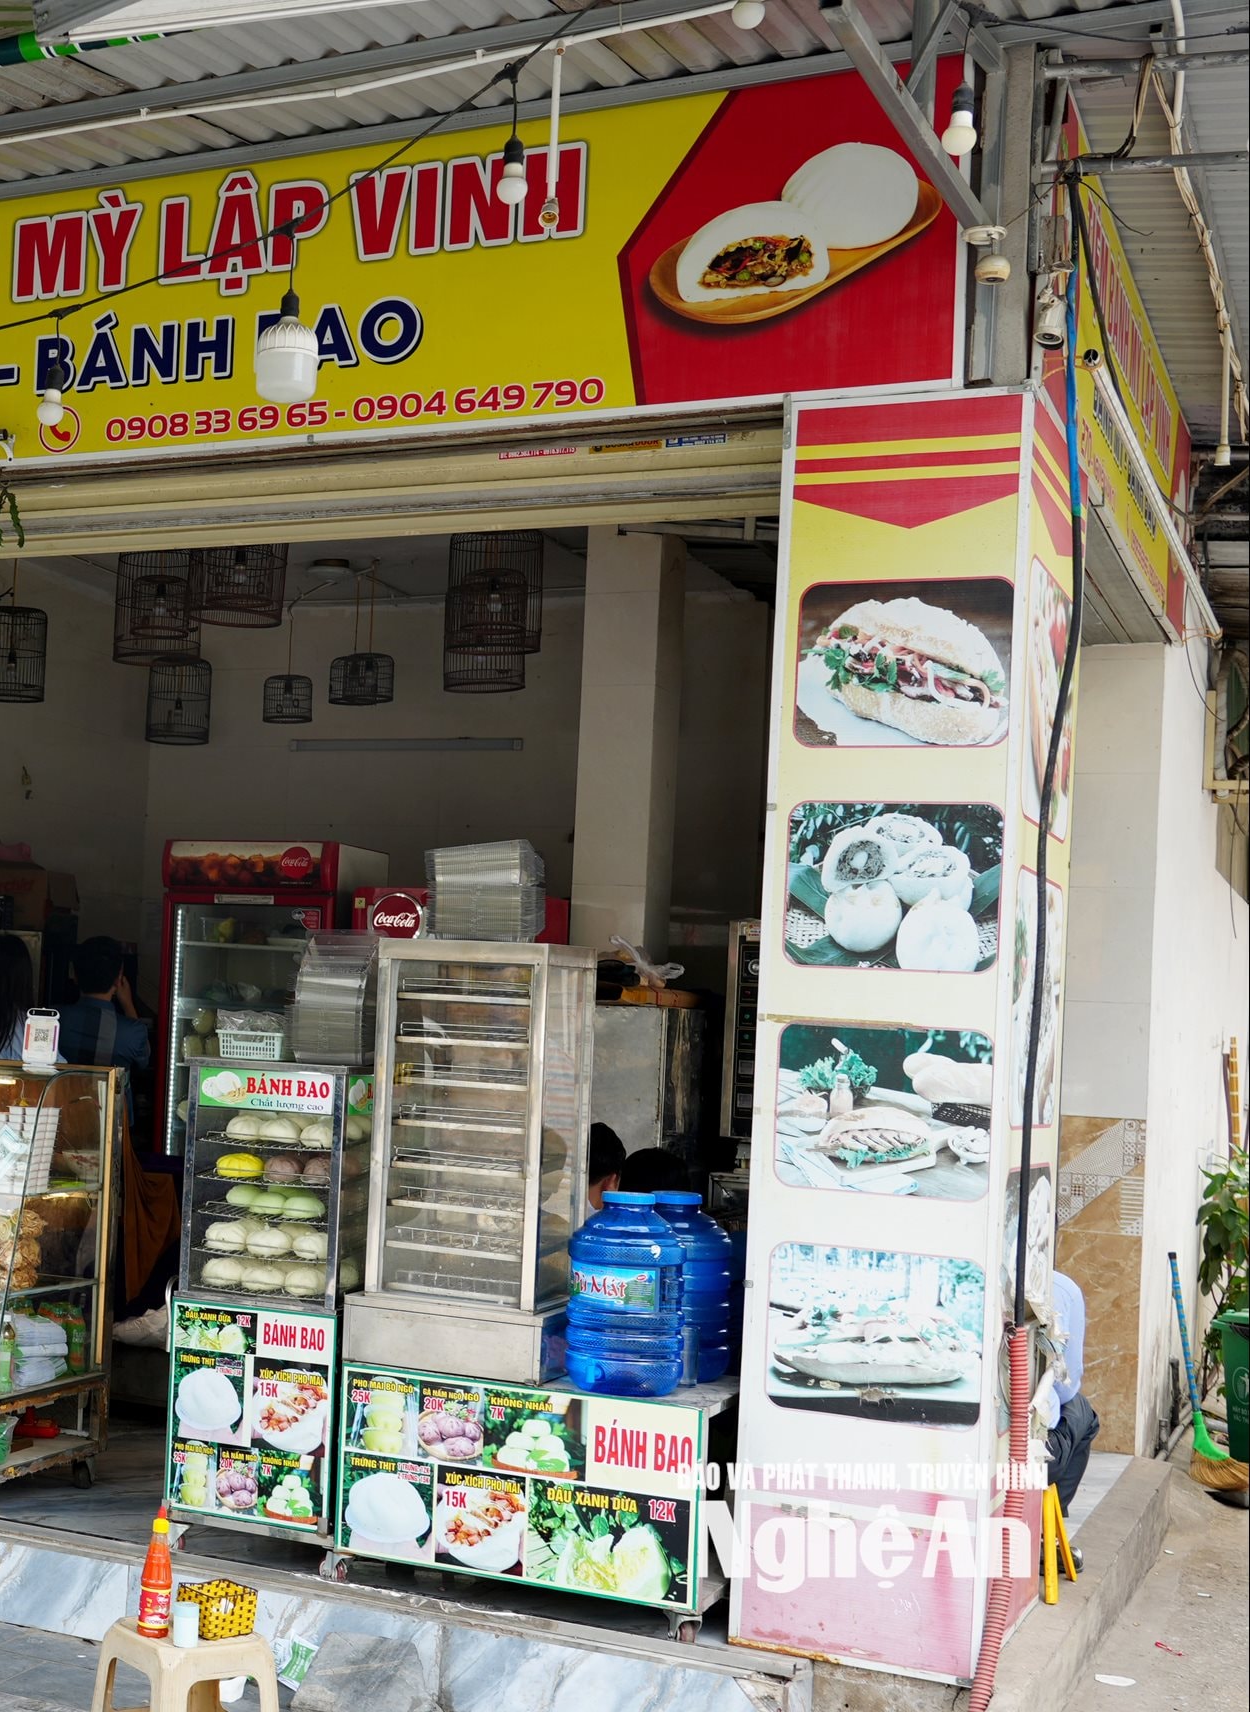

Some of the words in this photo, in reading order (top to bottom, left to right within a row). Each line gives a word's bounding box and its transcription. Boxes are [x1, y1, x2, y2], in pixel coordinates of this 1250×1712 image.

[12, 189, 143, 303] MỲ
[158, 170, 328, 296] LẬP
[352, 141, 588, 262] VINH
[35, 310, 235, 397] BÁNH
[255, 295, 423, 372] AO
[105, 417, 190, 443] 0908
[194, 411, 232, 436] 33
[238, 404, 280, 432] 69
[285, 401, 329, 428] 65
[352, 391, 447, 423] 0904
[453, 385, 526, 415] 649
[533, 377, 605, 409] 790
[246, 1073, 293, 1097] BÁNH
[296, 1080, 330, 1099] BAO
[306, 1103, 324, 1112] cao
[236, 1314, 252, 1328] 12K
[263, 1318, 297, 1349] BÁNH
[300, 1327, 325, 1351] BAO
[259, 1367, 275, 1380] XÚC
[260, 1381, 279, 1398] 15K
[369, 1380, 386, 1391] MAI
[351, 1389, 371, 1404] 25K
[424, 1397, 445, 1412] 20K
[491, 1396, 523, 1409] KHÔNG
[525, 1399, 553, 1413] NHÂN
[491, 1405, 506, 1421] 7K
[594, 1419, 647, 1470] BÁNH
[653, 1432, 693, 1475] BAO
[173, 1452, 187, 1464] 25K
[220, 1457, 234, 1469] 20K
[262, 1463, 272, 1476] 7K
[445, 1471, 465, 1486] XÚC
[465, 1473, 484, 1490] XÍCH
[502, 1480, 521, 1495] MAI
[444, 1490, 467, 1509] 15K
[546, 1487, 573, 1505] ĐẬU
[575, 1490, 610, 1510] XANH
[611, 1493, 638, 1514] DỪA
[648, 1498, 677, 1523] 12K
